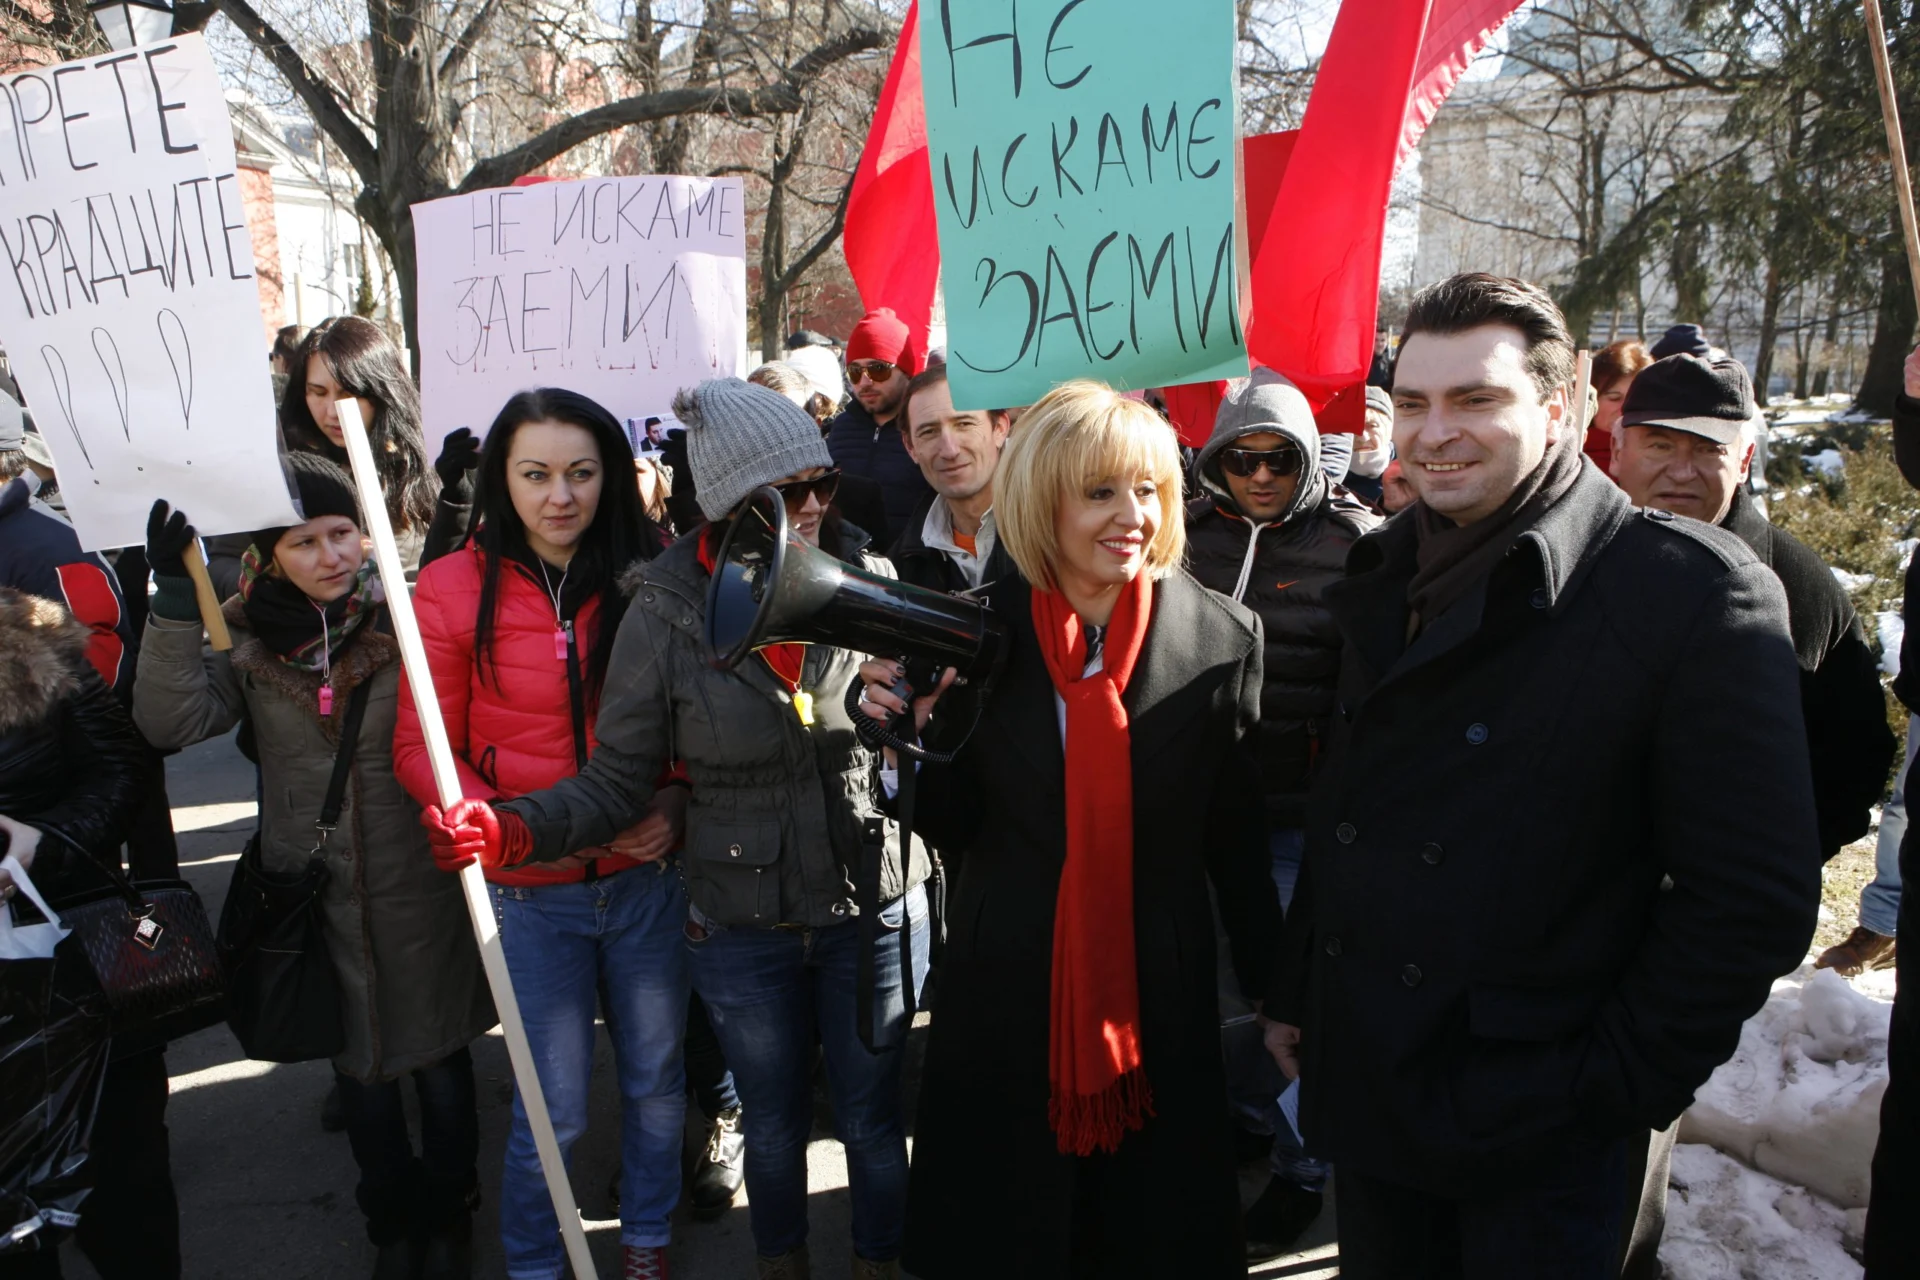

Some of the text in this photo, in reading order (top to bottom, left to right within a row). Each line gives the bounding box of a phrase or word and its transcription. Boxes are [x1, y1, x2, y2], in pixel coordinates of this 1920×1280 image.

[940, 0, 1093, 108] НЕ
[943, 98, 1222, 229] ИСКАМЕ
[472, 180, 738, 264] НЕ ИСКАМЕ
[445, 261, 677, 366] ЗАЕМИ
[954, 222, 1239, 374] ЗАЕМИ
